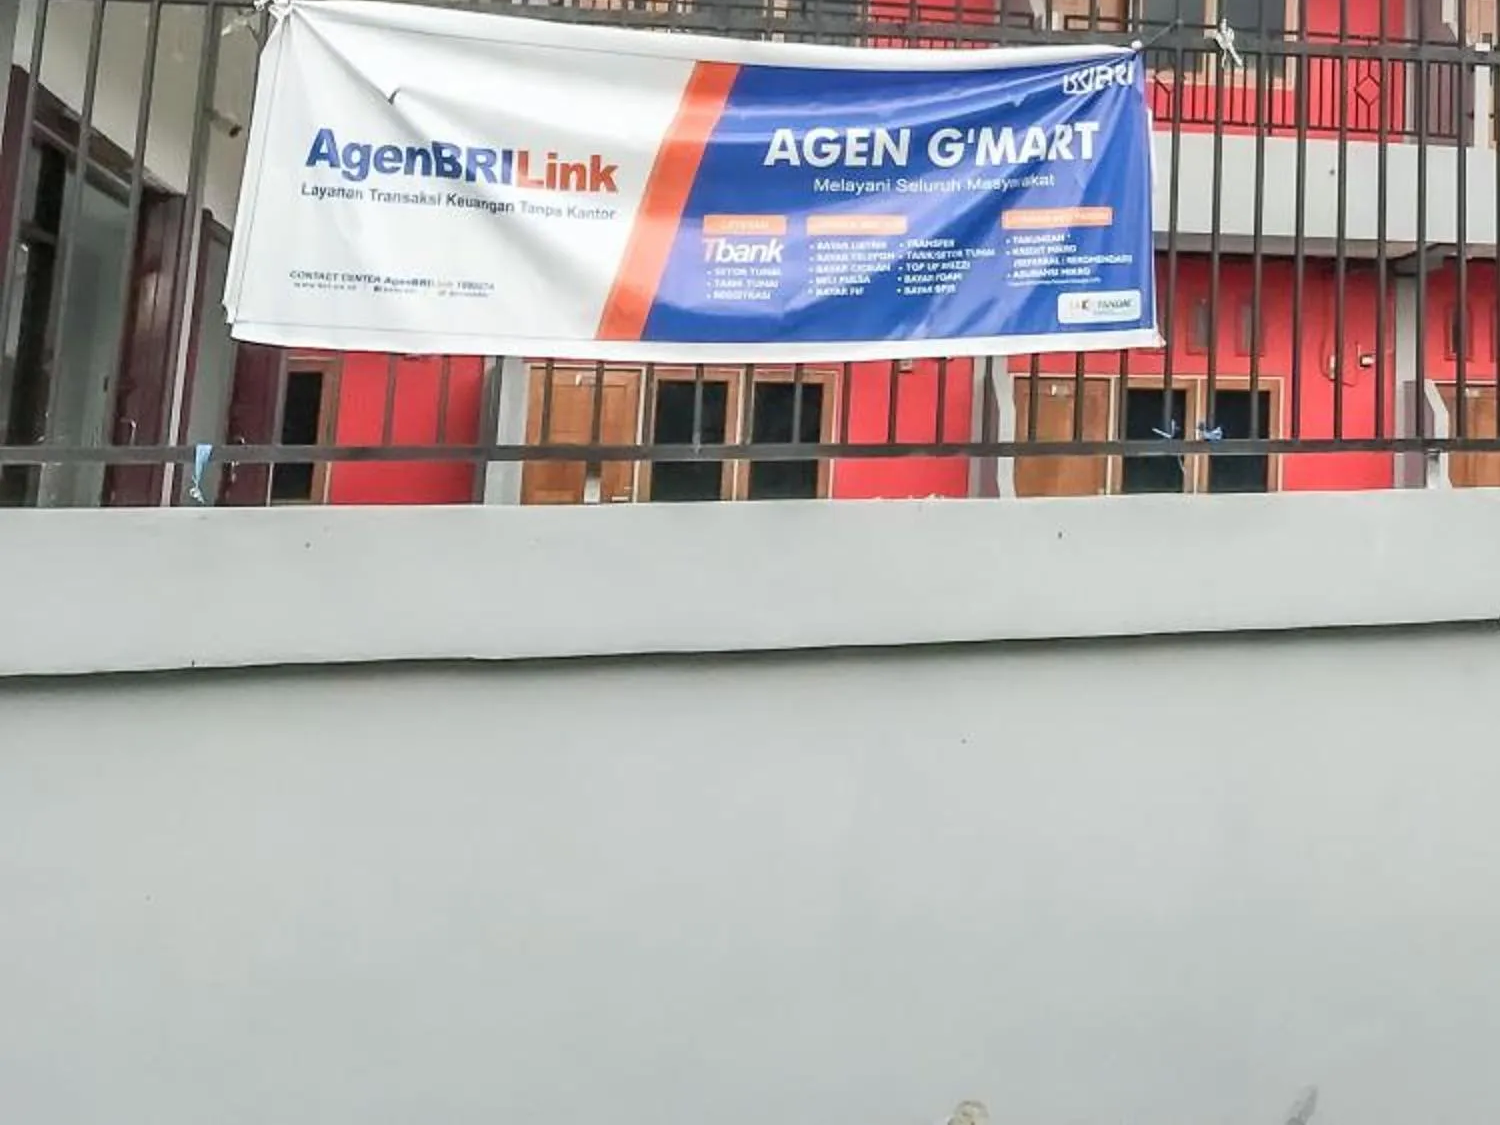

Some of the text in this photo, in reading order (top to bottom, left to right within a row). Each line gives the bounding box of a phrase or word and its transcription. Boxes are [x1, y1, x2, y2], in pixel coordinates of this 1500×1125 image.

[305, 127, 620, 193] AgenBRILink
[763, 121, 1100, 168] AGEN G'MART
[301, 182, 617, 221] Layanan Transaksi Keuangan Tanpa Kantor
[813, 178, 892, 195] Melayani
[895, 178, 961, 194] Seluruh
[703, 237, 784, 263] Tbank
